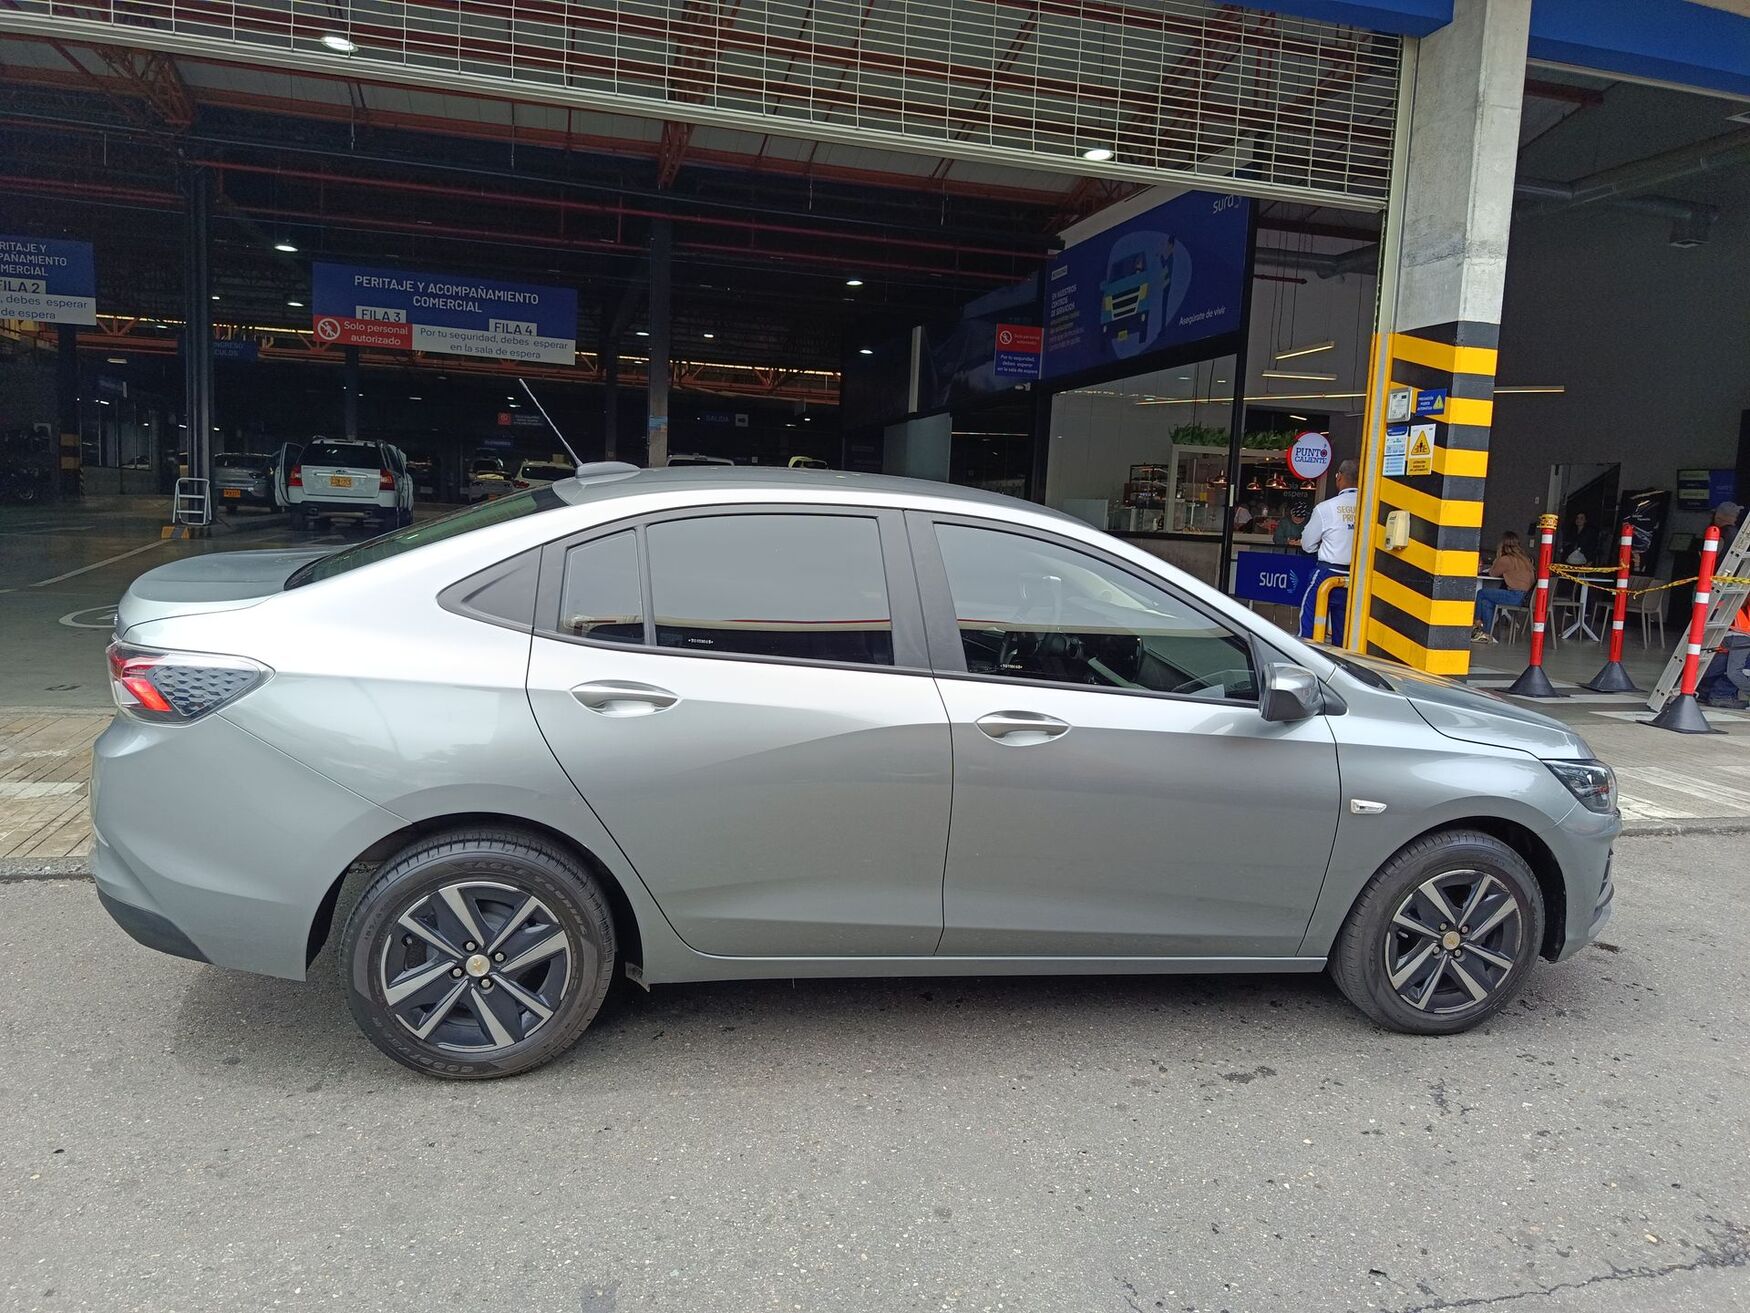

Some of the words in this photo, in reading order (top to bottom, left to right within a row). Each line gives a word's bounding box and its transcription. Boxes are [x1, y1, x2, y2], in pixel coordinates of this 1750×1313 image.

[1211, 195, 1234, 214] sura
[39, 244, 47, 253] Y
[31, 282, 40, 294] 2
[354, 275, 414, 291] PERITAJE
[417, 282, 425, 293] Y
[427, 282, 539, 305] ACOMPAÑAMIENTO
[6, 294, 41, 305] debes
[46, 299, 87, 310] esperar
[413, 295, 483, 313] COMERCIAL
[1, 307, 15, 317] de
[18, 311, 56, 320] espera
[361, 309, 390, 322] FILA
[393, 312, 401, 322] 3
[343, 321, 365, 331] Solo
[367, 324, 408, 335] personal
[494, 322, 522, 335] FILA
[525, 325, 534, 336] 4
[351, 334, 401, 345] autorizado
[420, 328, 436, 338] Por
[438, 330, 448, 338] tu
[449, 331, 499, 344] seguridad,
[500, 336, 529, 347] debes
[533, 340, 569, 351] esperar
[464, 344, 473, 353] la
[474, 345, 494, 355] sala
[495, 347, 508, 356] de
[509, 350, 541, 360] espera
[1295, 447, 1328, 458] PUNTO
[1259, 571, 1287, 589] sura
